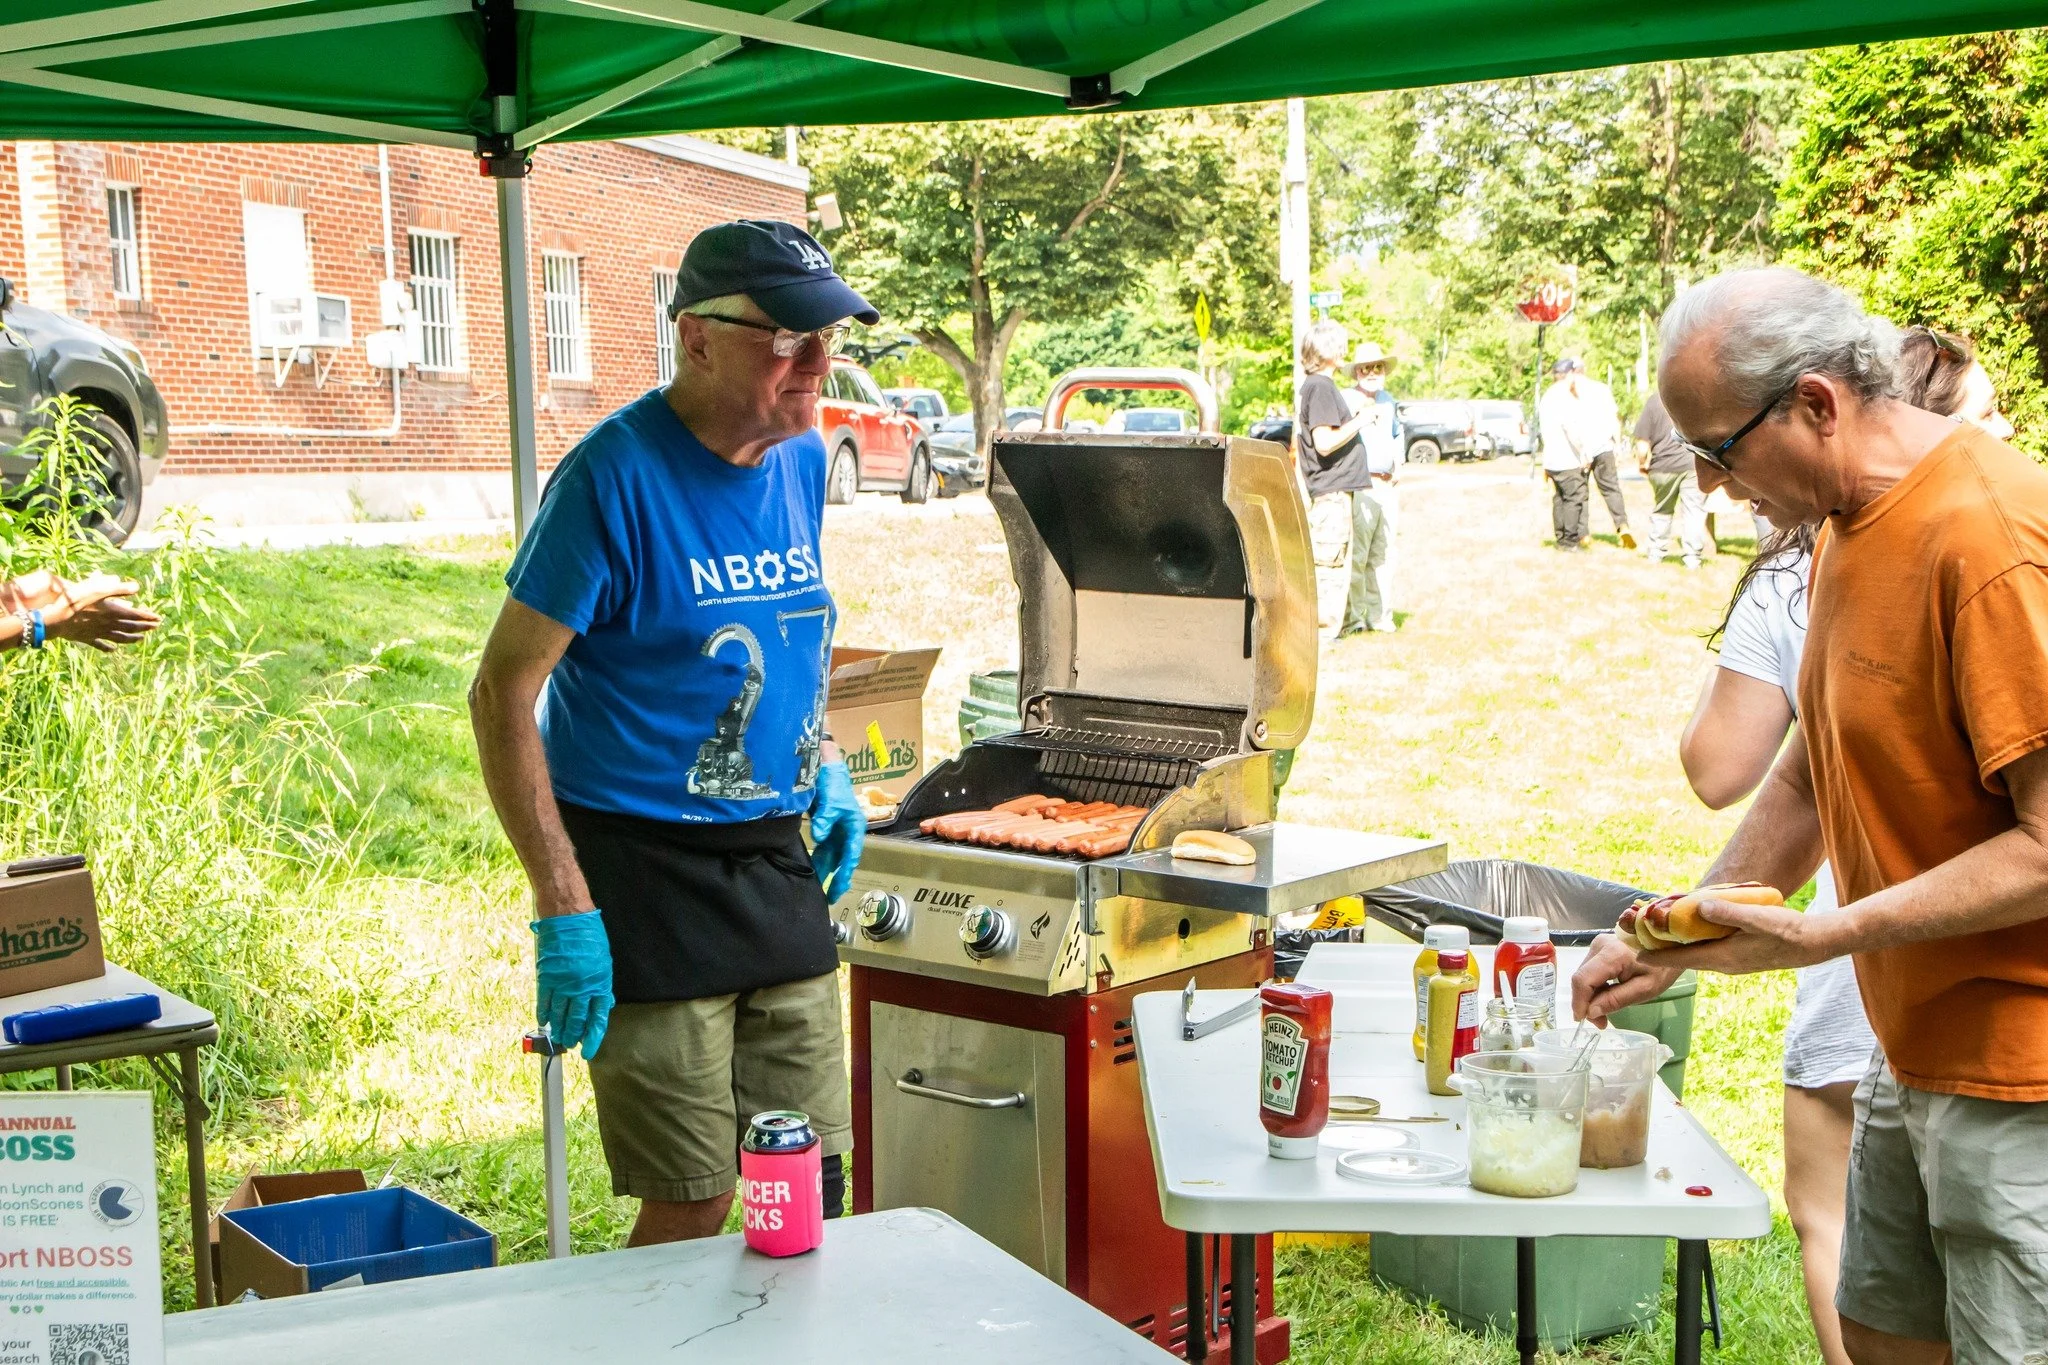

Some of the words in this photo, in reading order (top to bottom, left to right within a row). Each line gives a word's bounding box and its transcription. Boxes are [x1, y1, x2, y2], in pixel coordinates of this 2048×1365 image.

[788, 240, 830, 270] LA
[1519, 281, 1571, 307] TOP
[689, 545, 819, 594] NBOSS
[697, 598, 722, 607] NORTH
[723, 595, 760, 604] BENNINGTON
[760, 593, 787, 601] OUTDOOR
[841, 739, 915, 773] athn's
[0, 917, 84, 957] han's
[1269, 1022, 1293, 1038] HEINZ
[1265, 1040, 1297, 1059] TOMATO
[1266, 1052, 1295, 1067] KETCHUP
[0, 1135, 76, 1162] OSS
[12, 1183, 54, 1196] Lynch
[58, 1182, 84, 1194] and
[743, 1179, 792, 1204] NCER
[0, 1198, 84, 1211] oonScones
[3, 1215, 16, 1226] IS
[743, 1204, 784, 1231] CKS
[37, 1246, 133, 1268] NBOSS
[20, 1279, 34, 1287] Art
[36, 1279, 55, 1288] free
[57, 1278, 75, 1287] and
[16, 1293, 43, 1301] dollar
[46, 1291, 76, 1300] makes
[86, 1290, 137, 1300] difference.
[2, 1340, 32, 1352] your
